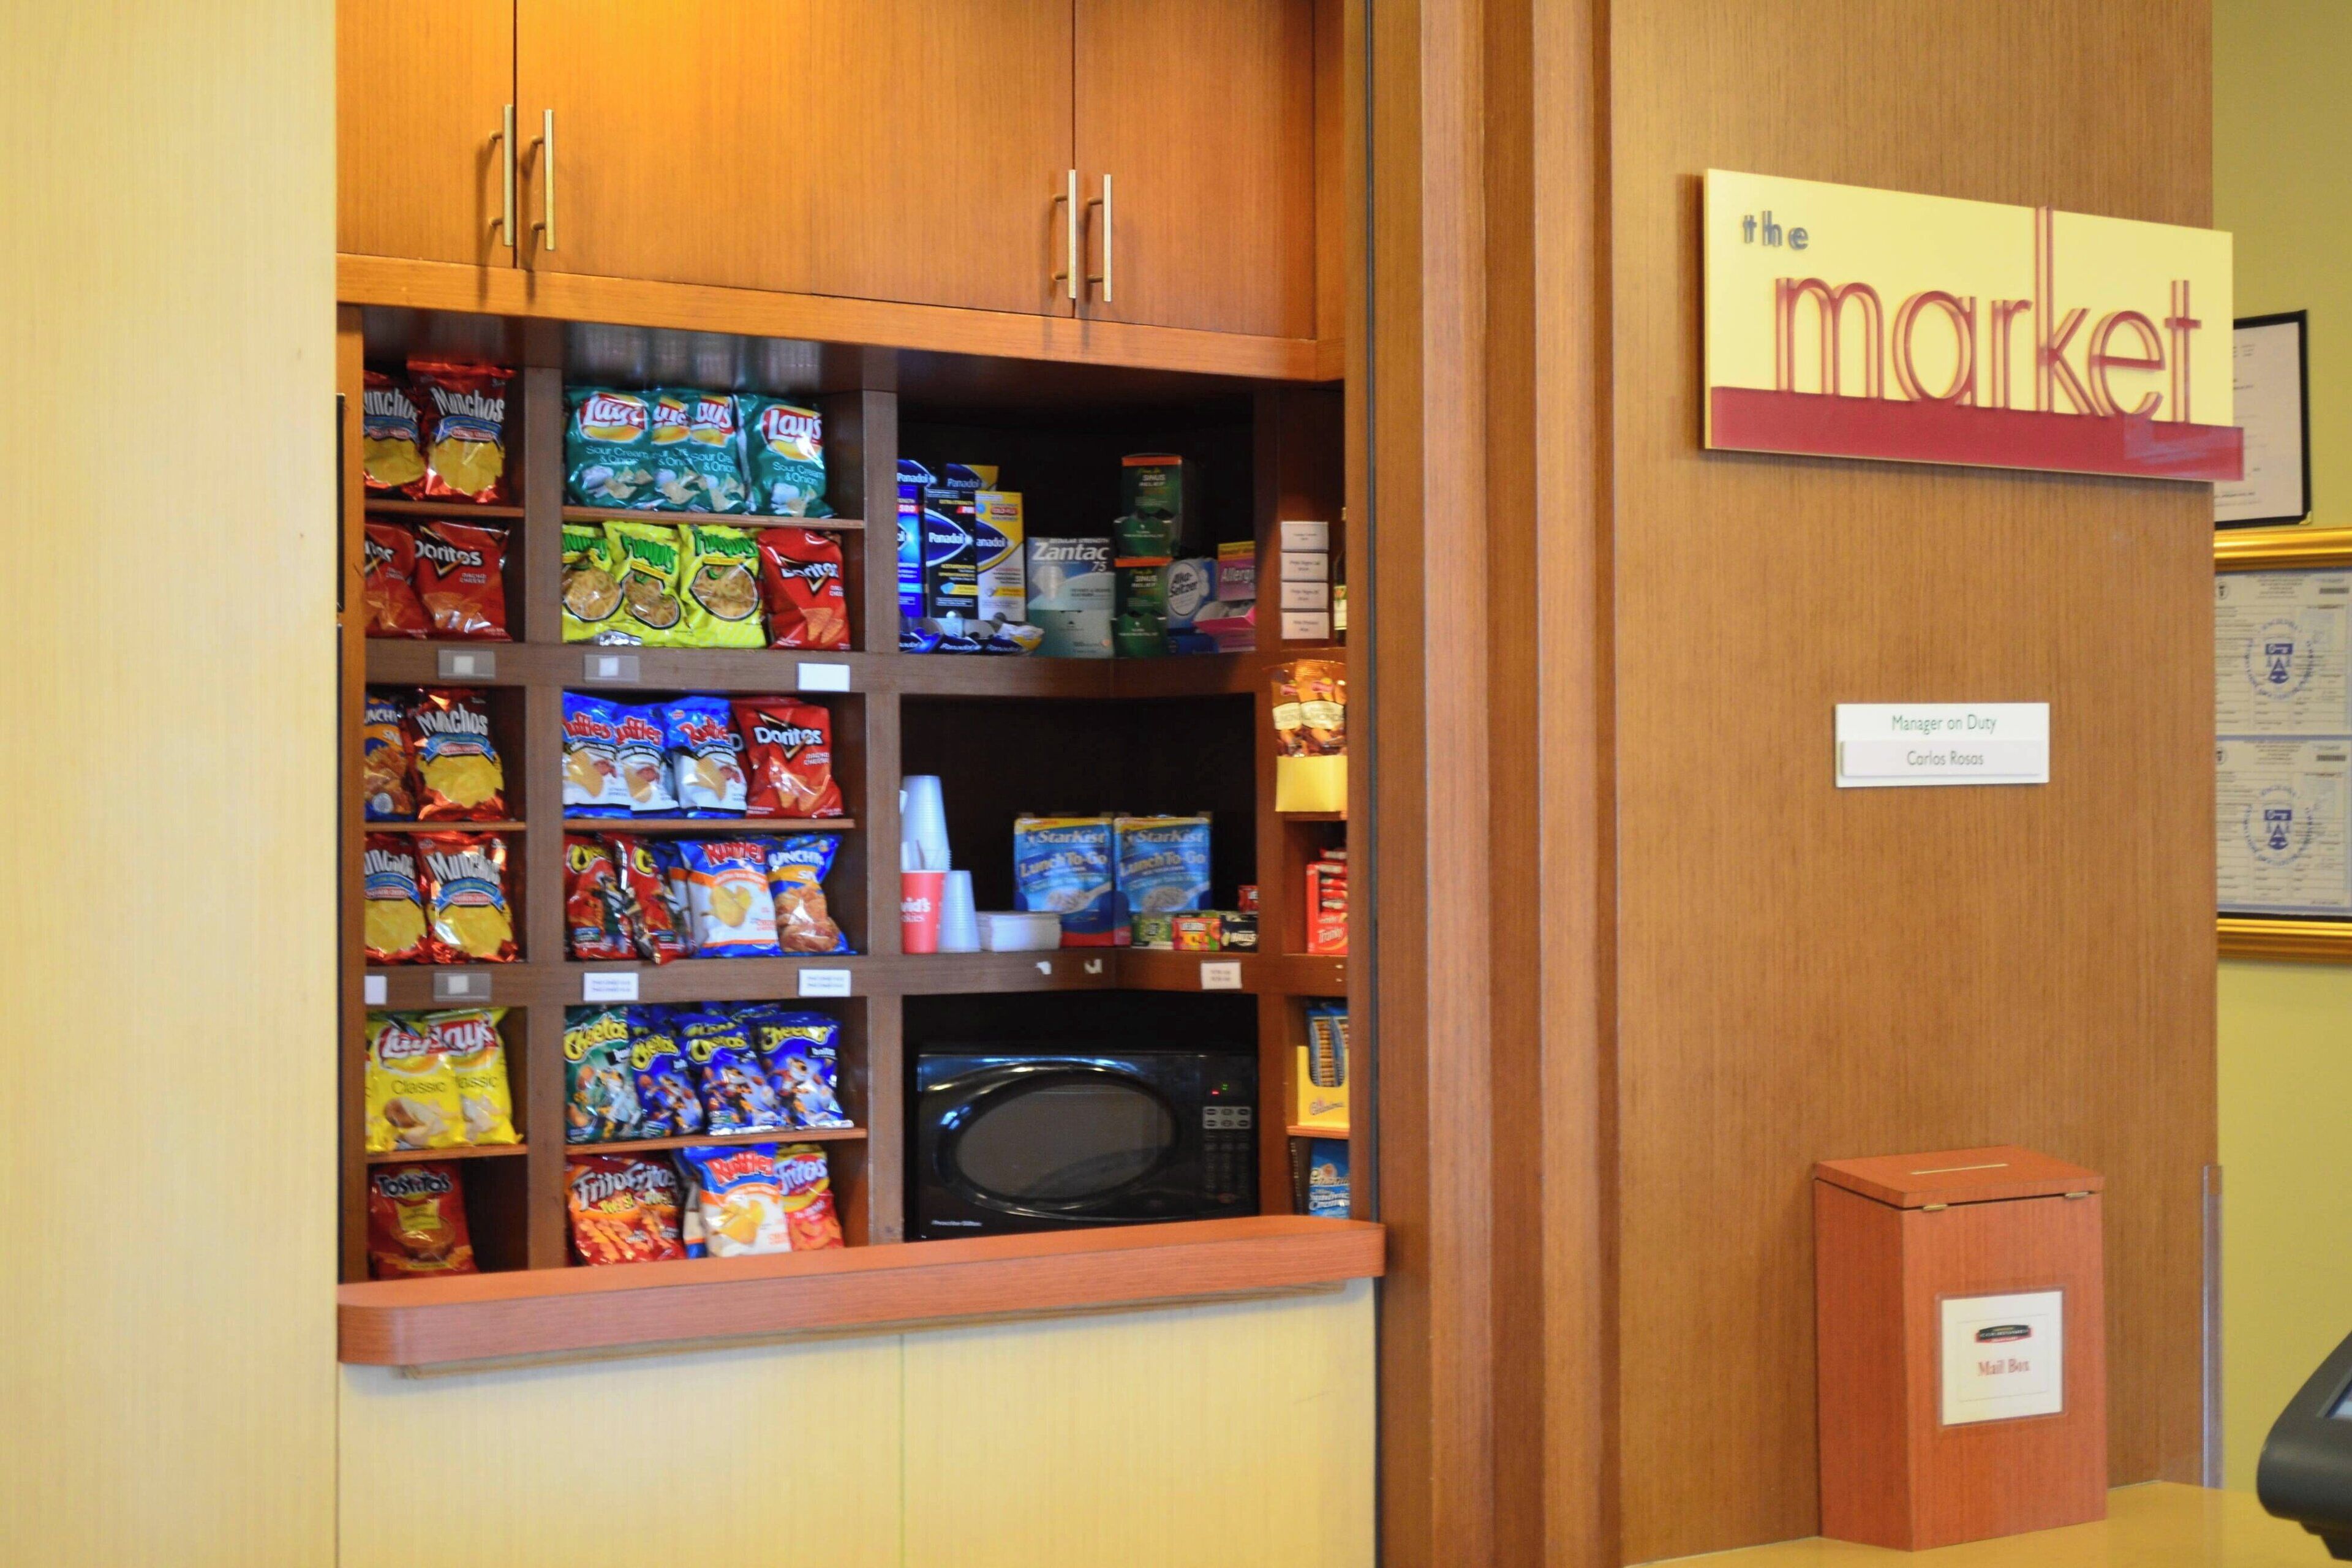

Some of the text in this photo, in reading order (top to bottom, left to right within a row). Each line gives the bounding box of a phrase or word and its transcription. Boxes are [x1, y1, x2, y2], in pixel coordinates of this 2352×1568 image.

[1743, 210, 1809, 249] the
[1776, 206, 2201, 418] market
[429, 386, 505, 422] Munchos
[768, 409, 823, 443] Lay's
[586, 445, 611, 456] Sour
[773, 462, 796, 472] Sour
[791, 472, 818, 485] Onion
[947, 478, 979, 488] Panadol
[928, 532, 963, 544] Panadol
[976, 538, 1006, 548] anadol
[1031, 541, 1110, 561] Zantac
[1091, 561, 1107, 573] 75
[1169, 581, 1197, 597] Seltzer
[1892, 714, 1997, 735] Manager on Duty
[754, 726, 823, 746] Doritos
[1907, 750, 1946, 766] Carlos
[391, 1079, 447, 1095] Classic
[774, 1158, 828, 1196] Fritos
[570, 1170, 627, 1212] Frito
